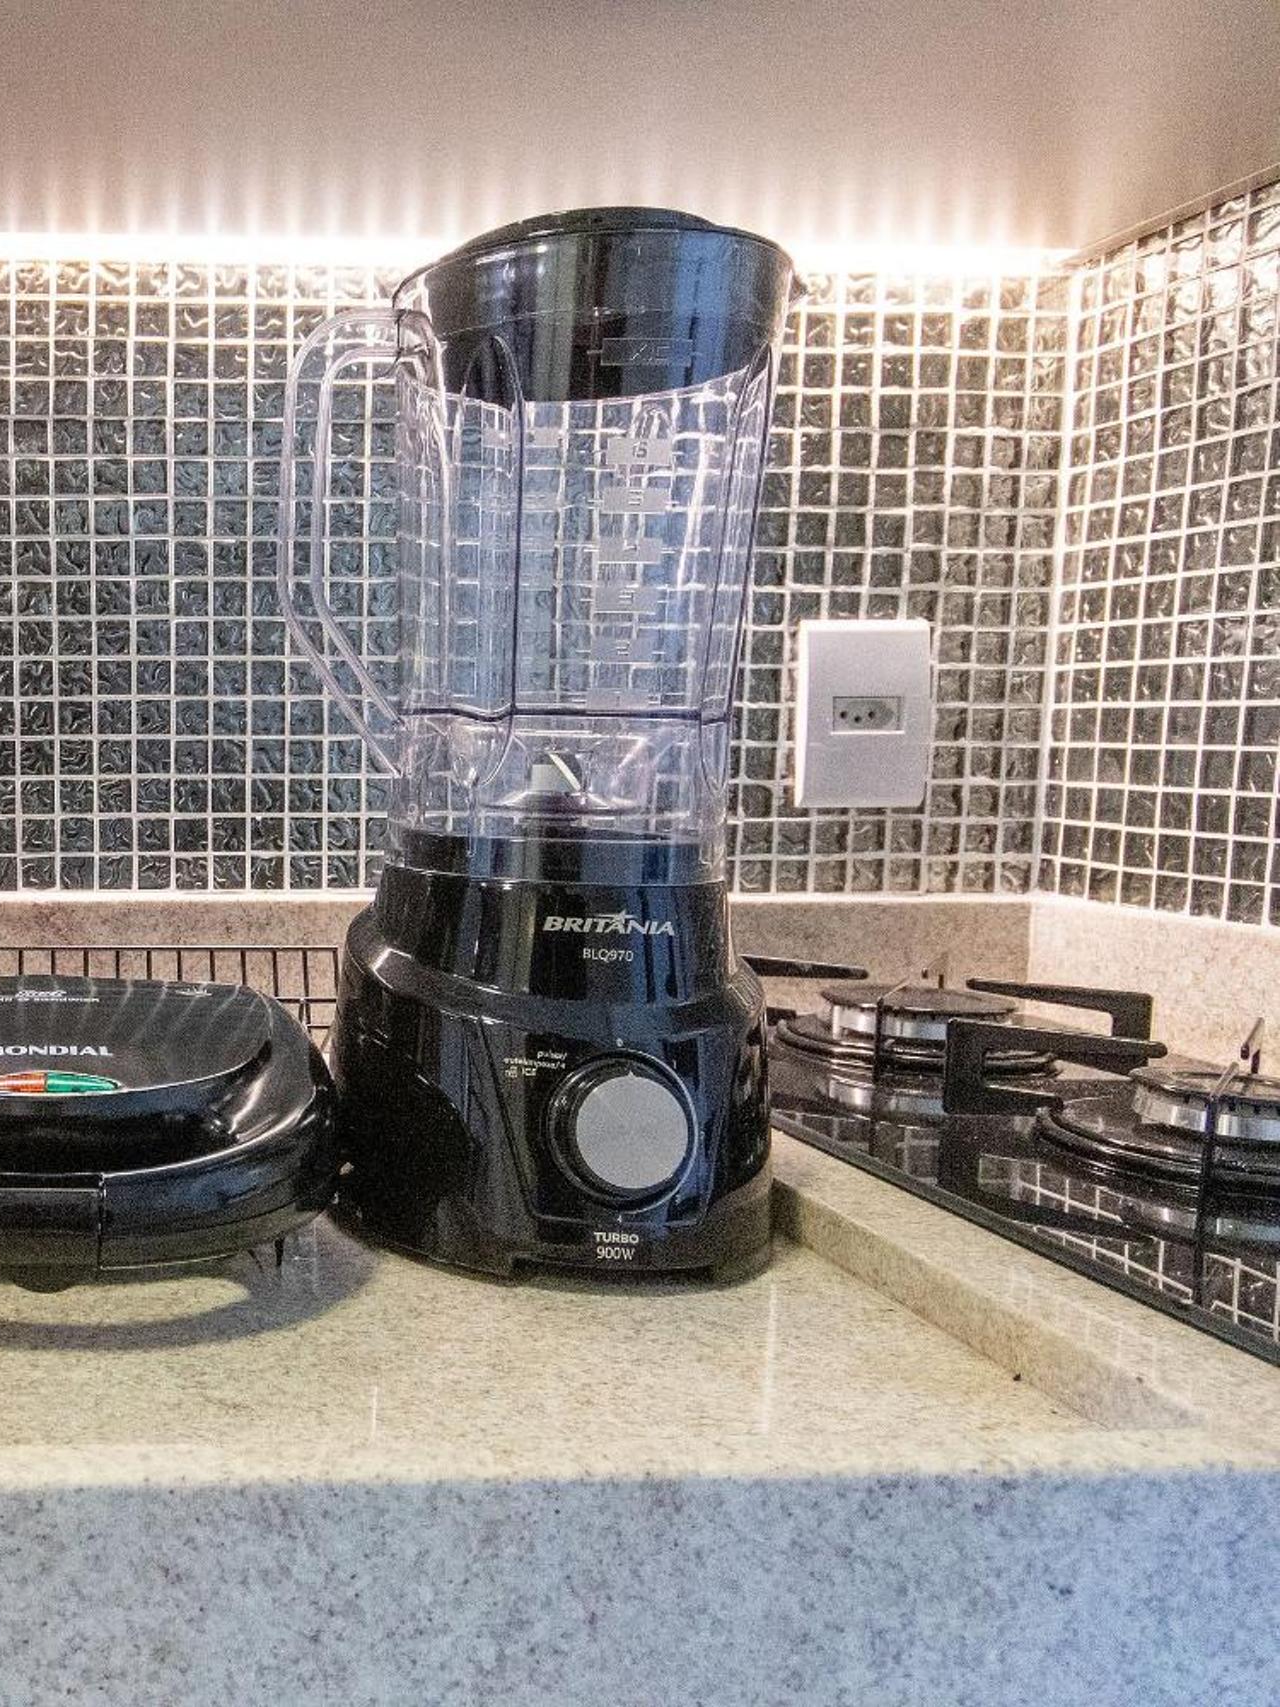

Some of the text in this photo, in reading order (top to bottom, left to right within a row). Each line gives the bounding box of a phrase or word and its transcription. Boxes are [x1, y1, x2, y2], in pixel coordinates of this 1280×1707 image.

[582, 947, 635, 963] BLQ970
[593, 1231, 640, 1245] TURBO
[596, 1247, 636, 1261] 900W
